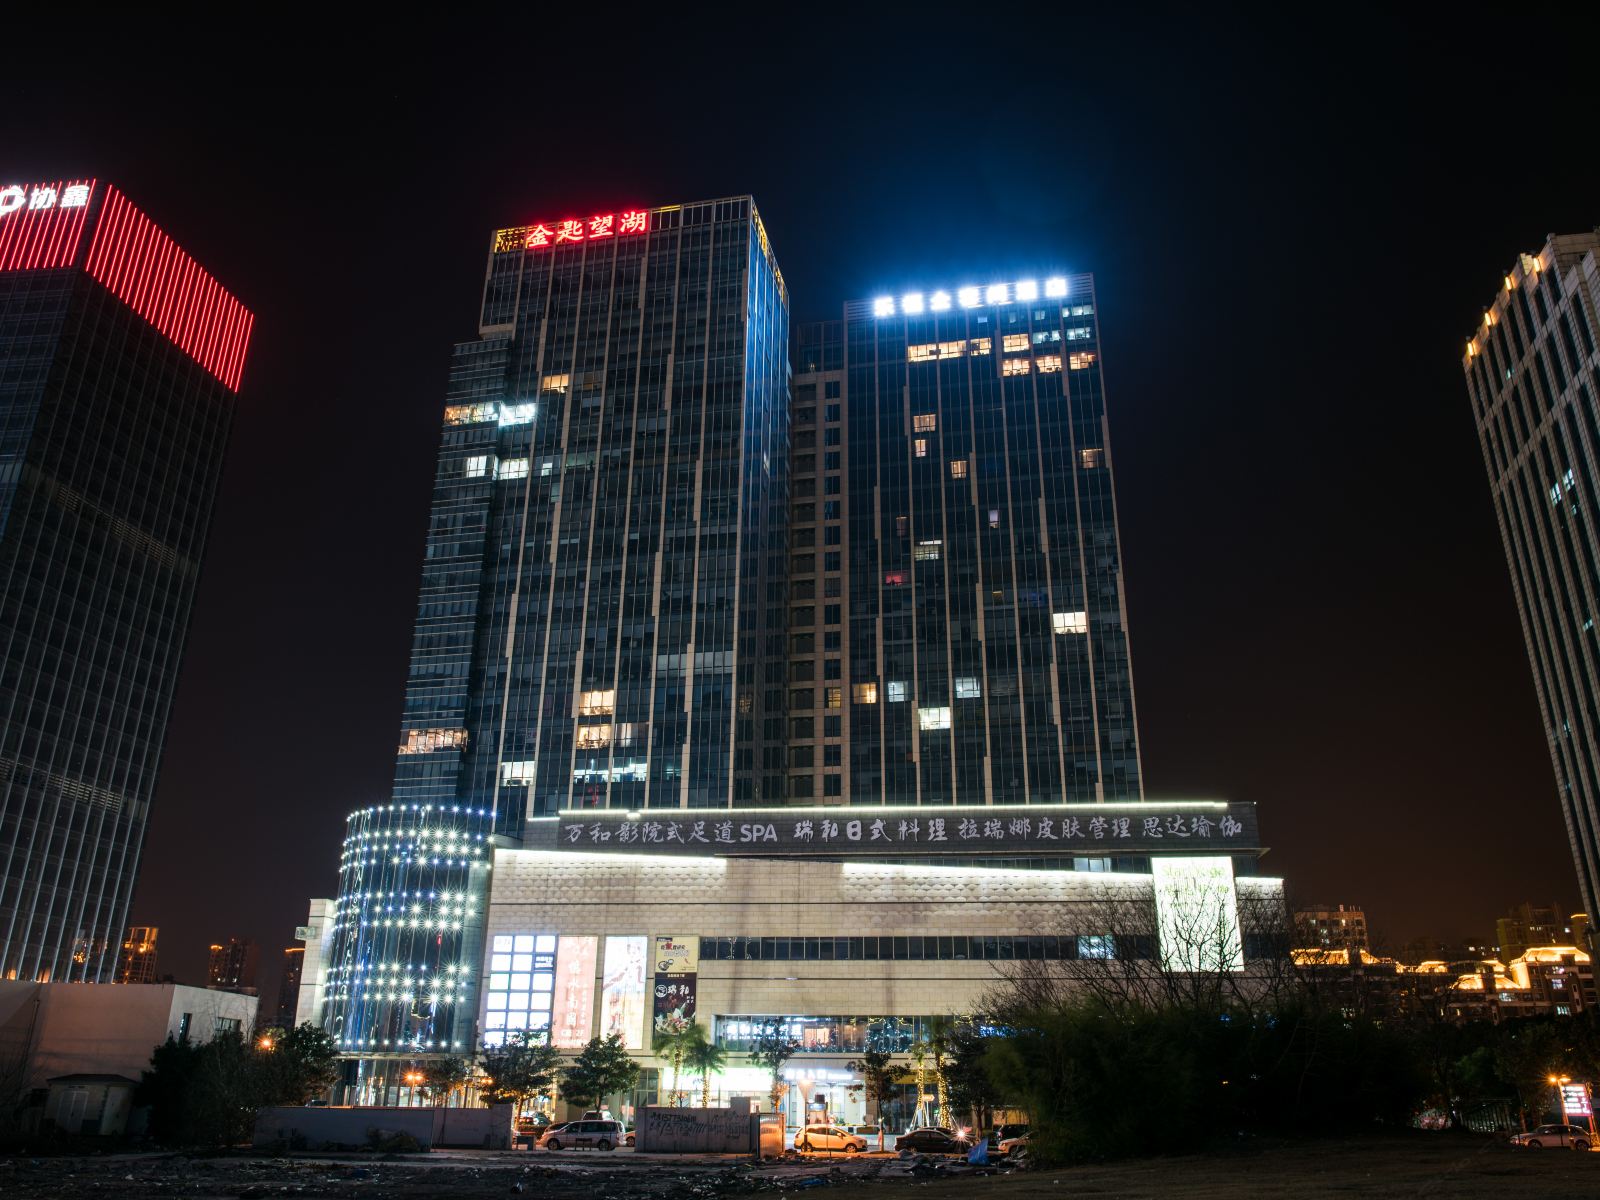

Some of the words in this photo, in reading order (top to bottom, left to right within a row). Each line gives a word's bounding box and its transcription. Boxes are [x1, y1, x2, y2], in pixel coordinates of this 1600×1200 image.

[28, 184, 90, 210] 协鑫
[526, 210, 650, 249] 金匙望湖
[793, 817, 948, 843] 瑞和日式料理
[958, 816, 1132, 841] 拉瑞娜皮肤管理
[1142, 814, 1243, 839] 思达瑜伽
